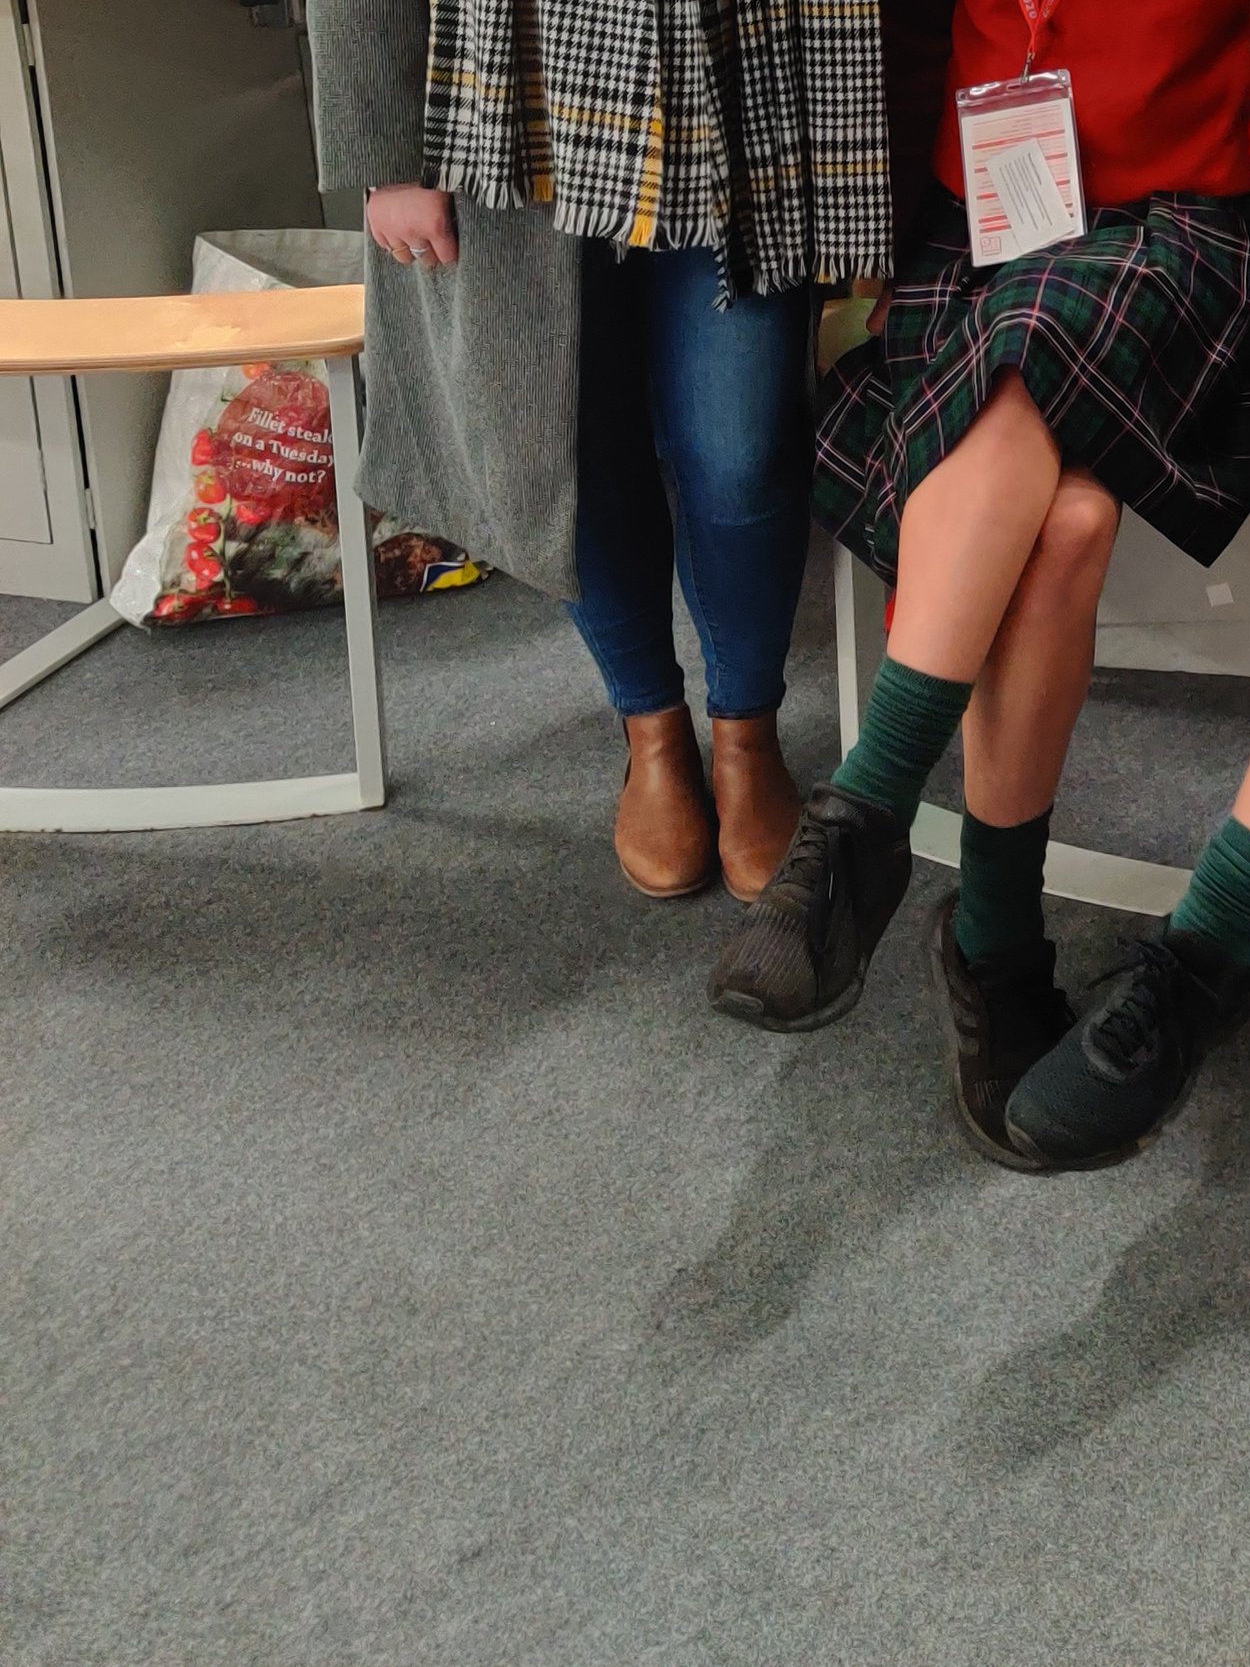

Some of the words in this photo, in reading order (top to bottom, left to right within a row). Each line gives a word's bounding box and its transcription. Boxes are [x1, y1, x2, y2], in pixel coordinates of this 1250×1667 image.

[247, 406, 286, 435] Fillet
[233, 430, 254, 448] on
[254, 436, 266, 451] a
[284, 467, 327, 485] not?
